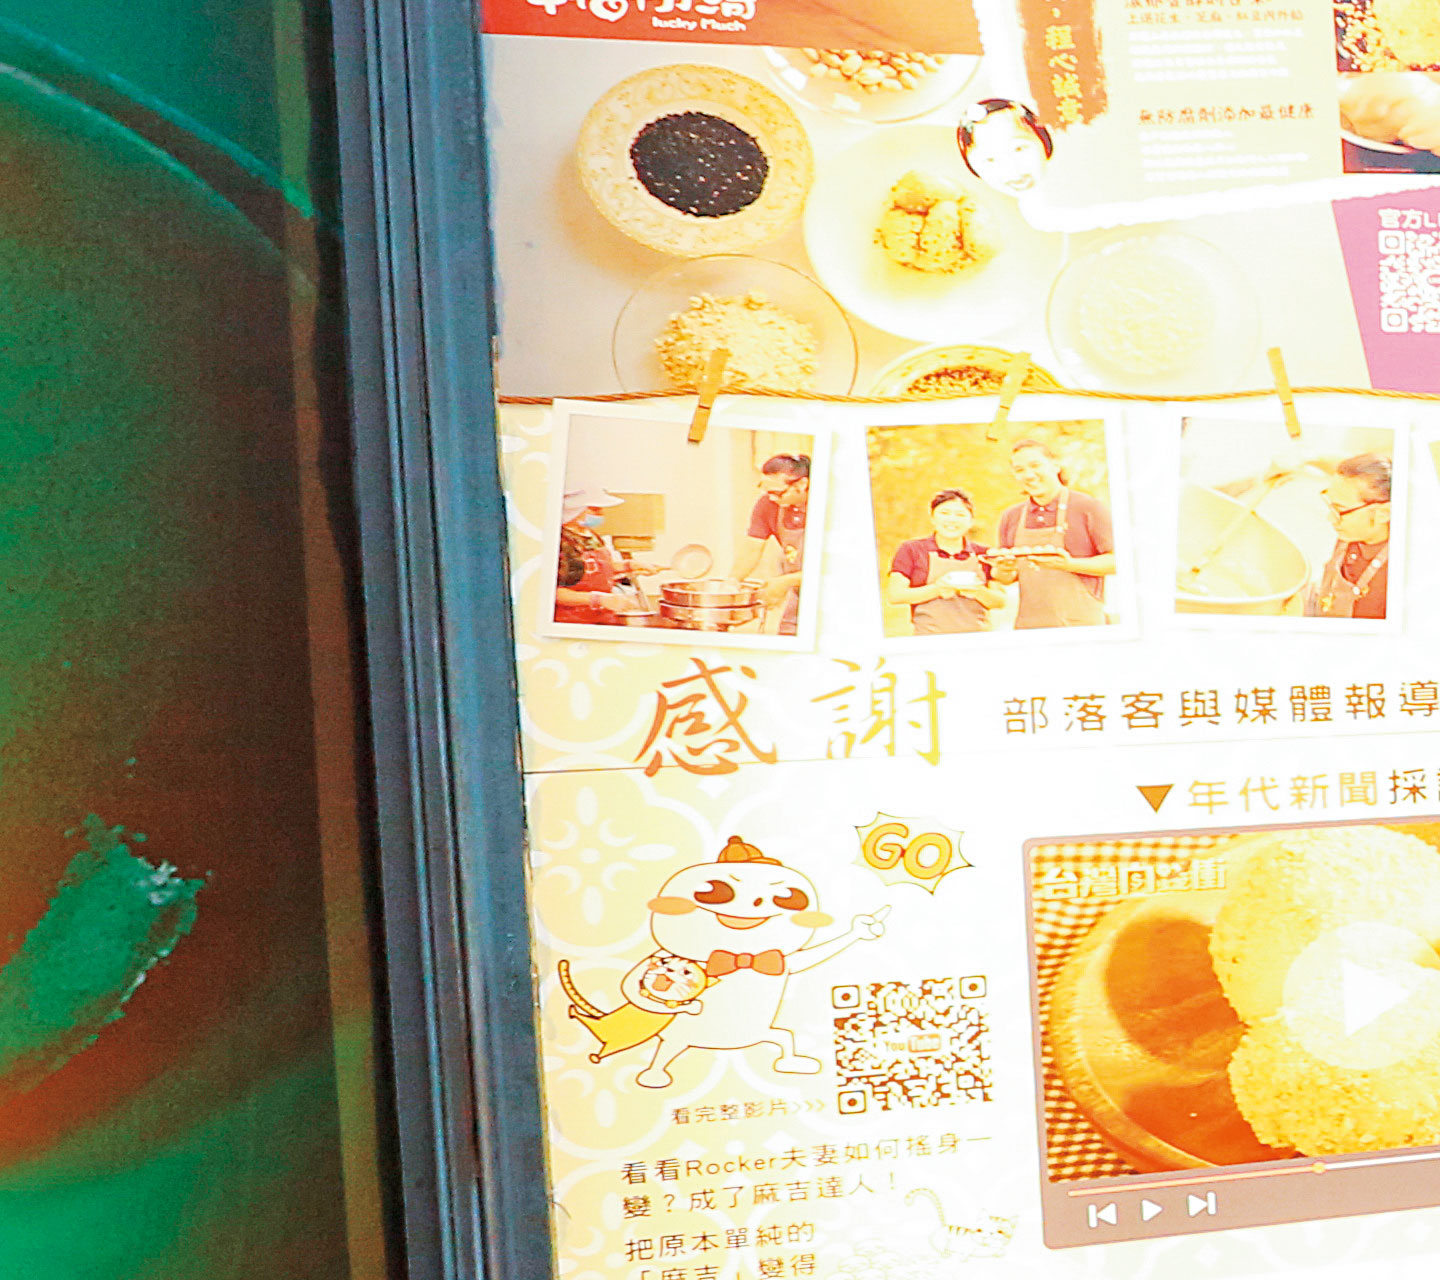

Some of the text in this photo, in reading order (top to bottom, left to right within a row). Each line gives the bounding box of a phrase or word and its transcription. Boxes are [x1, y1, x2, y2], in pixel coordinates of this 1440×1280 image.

[632, 656, 948, 778] 感謝
[862, 821, 953, 881] GO
[671, 1099, 788, 1126] 看完整影片
[620, 1133, 994, 1186] 看看Rocker夫妻如何搖身一
[624, 1221, 816, 1262] 把原本單純的
